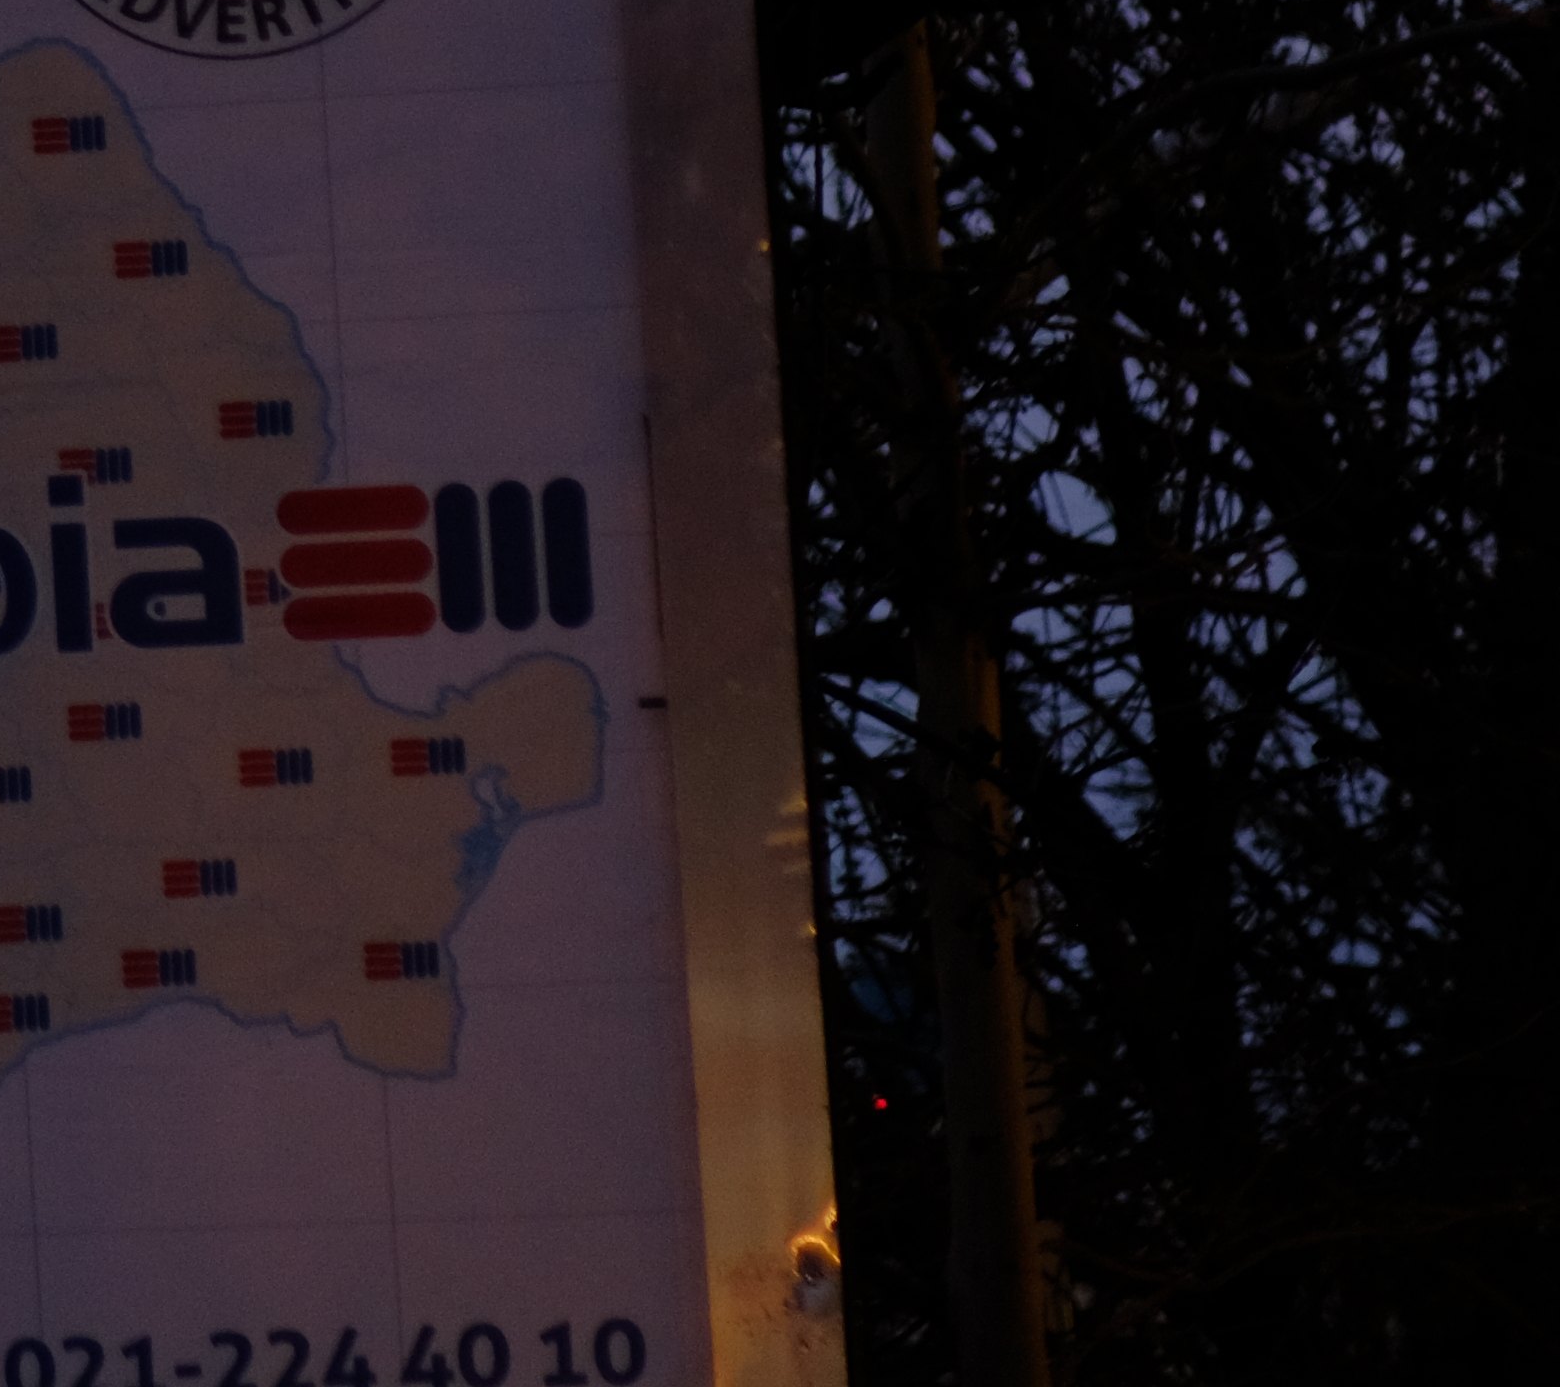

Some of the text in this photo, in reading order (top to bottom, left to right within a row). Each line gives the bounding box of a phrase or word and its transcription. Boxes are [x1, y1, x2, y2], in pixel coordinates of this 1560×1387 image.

[3, 1326, 377, 1387] 021-224
[399, 1322, 511, 1387] 40
[539, 1317, 647, 1387] 10
